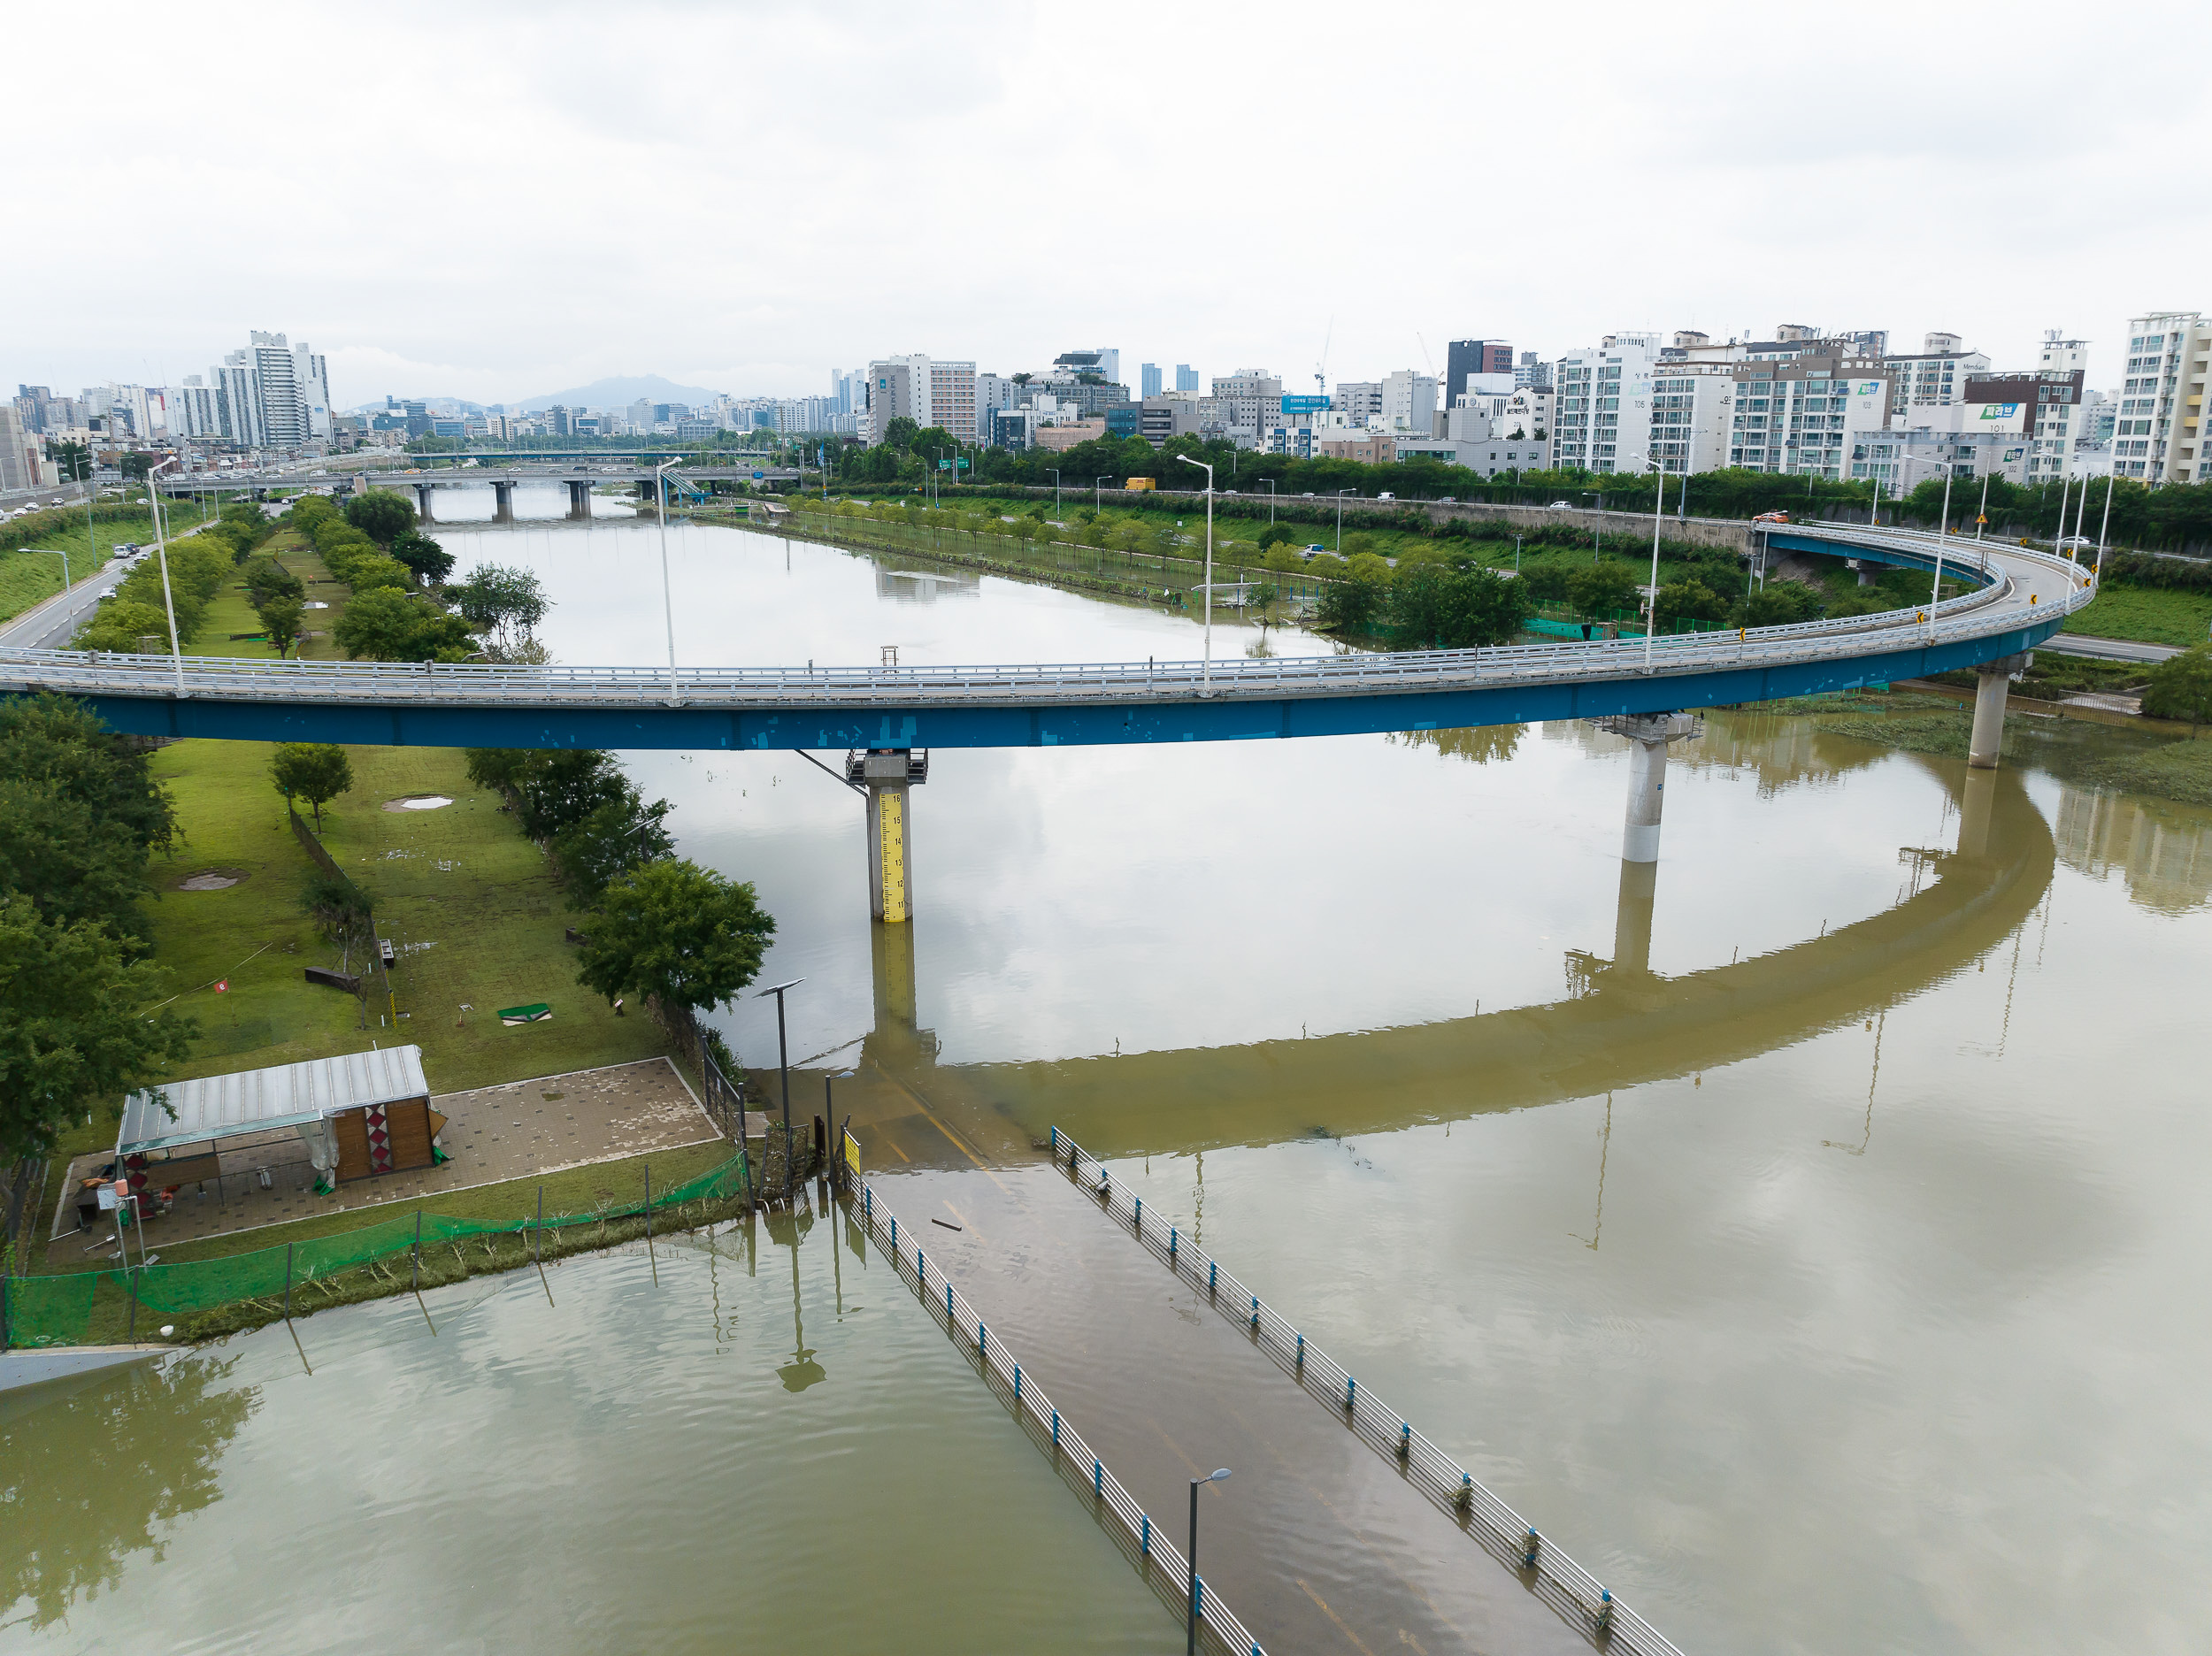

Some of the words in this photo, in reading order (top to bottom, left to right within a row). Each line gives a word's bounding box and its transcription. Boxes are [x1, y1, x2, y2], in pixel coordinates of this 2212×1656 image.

[1634, 400, 1645, 409] 105
[1985, 406, 2013, 417] 파라브
[894, 794, 901, 803] 16
[894, 816, 901, 824] 15
[895, 837, 902, 846] 14
[895, 858, 902, 867] 13
[897, 879, 903, 888] 12
